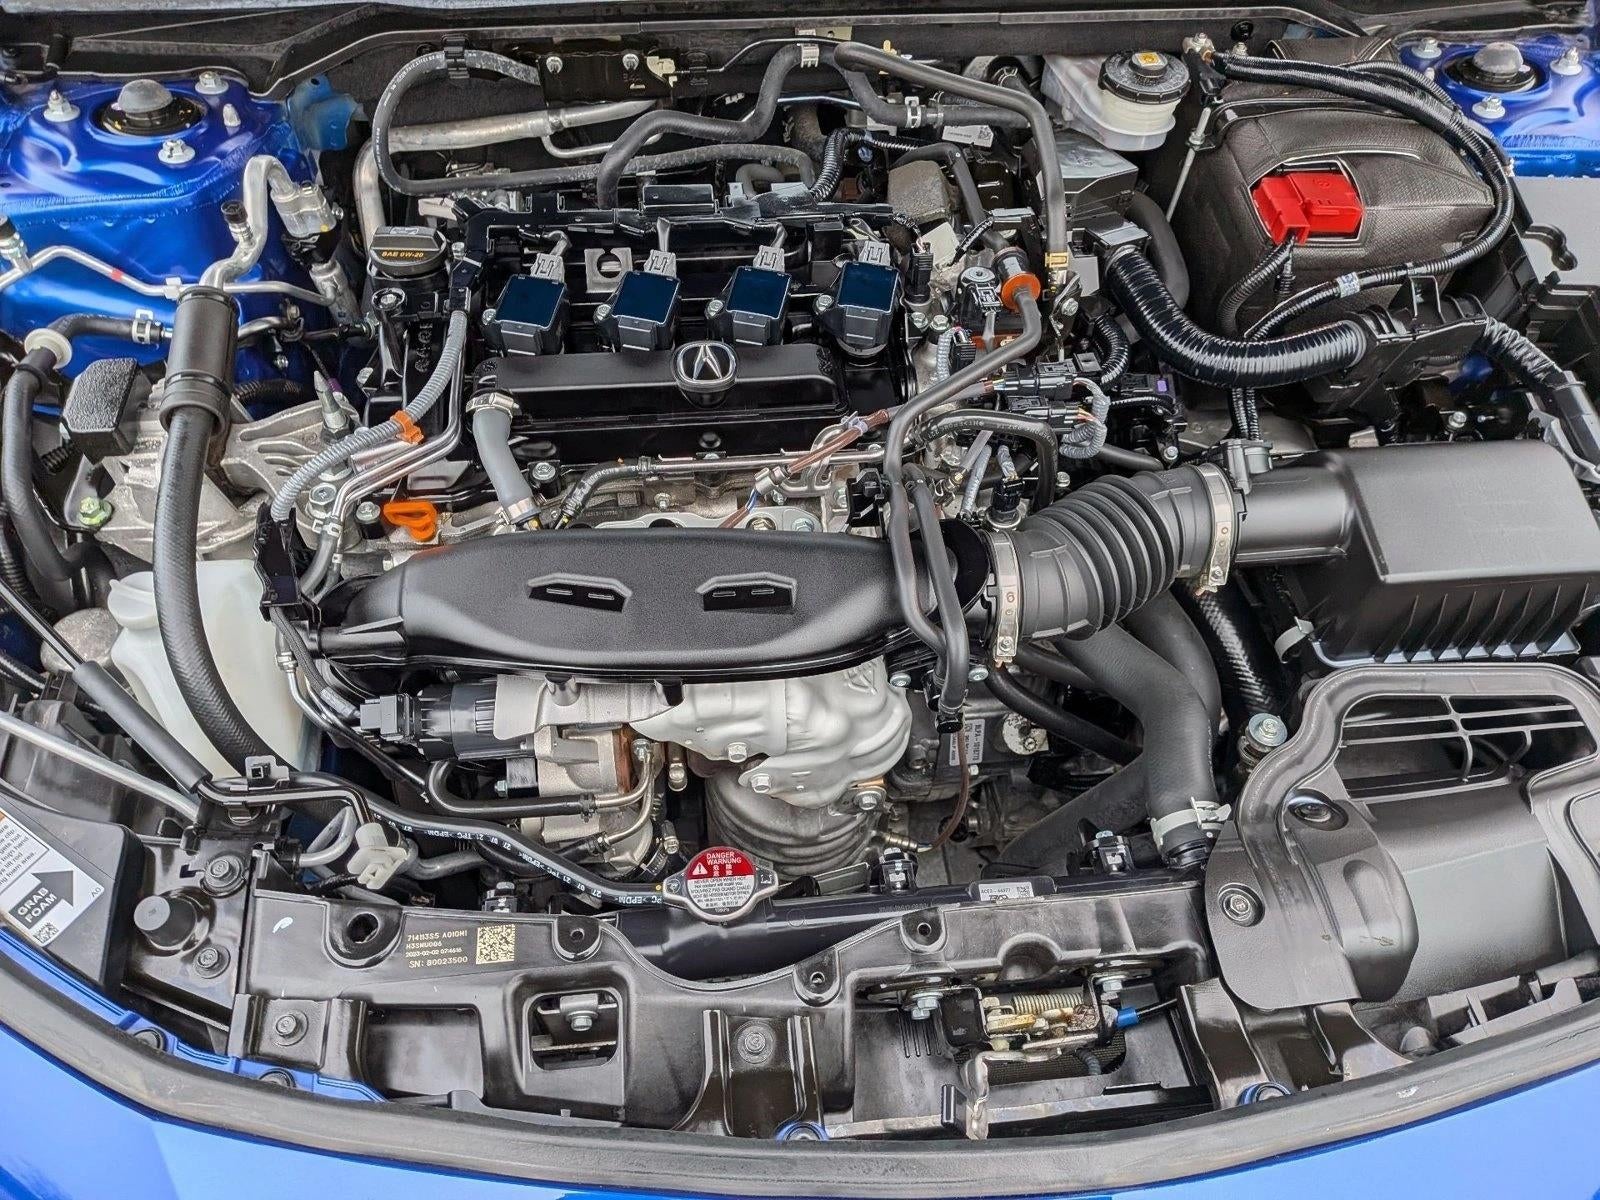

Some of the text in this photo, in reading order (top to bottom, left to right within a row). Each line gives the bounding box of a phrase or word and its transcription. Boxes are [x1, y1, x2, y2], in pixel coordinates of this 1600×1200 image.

[706, 851, 735, 859] DANGER
[706, 857, 742, 866] WARNUNG
[17, 886, 49, 916] GRAB
[25, 893, 58, 923] FOAM
[408, 959, 425, 969] SN:
